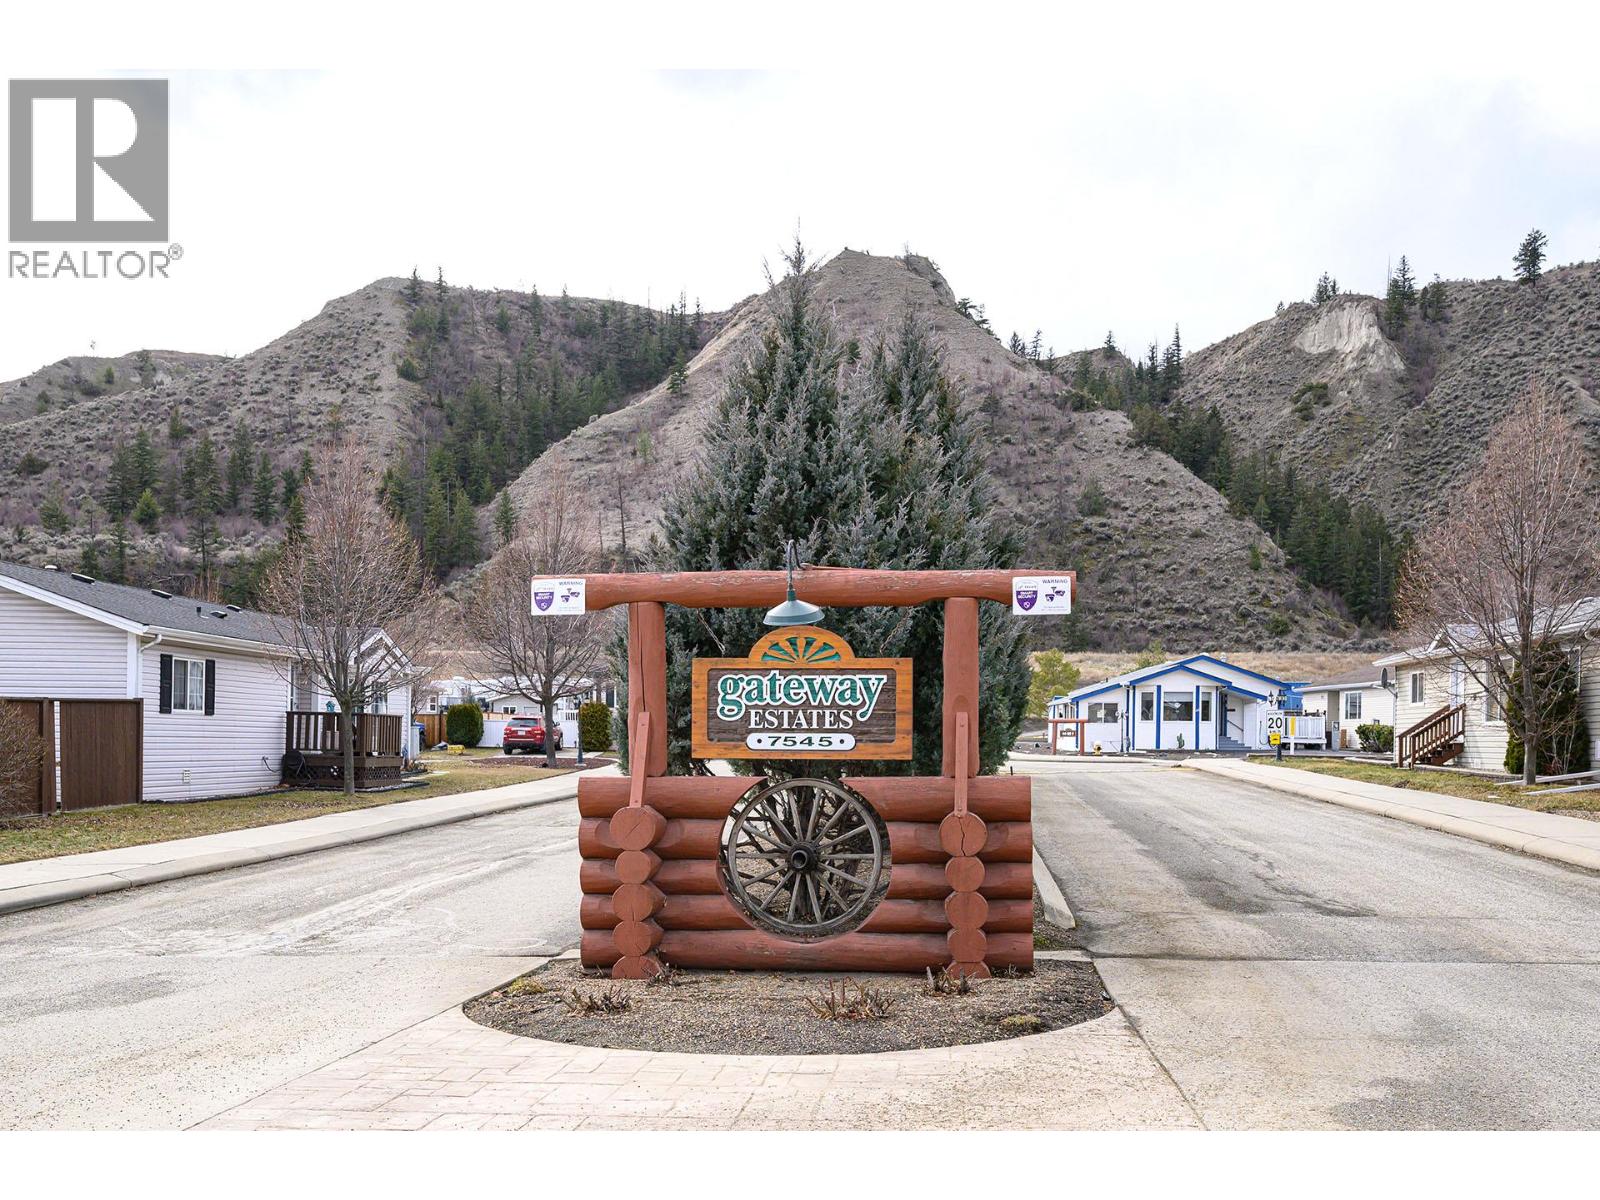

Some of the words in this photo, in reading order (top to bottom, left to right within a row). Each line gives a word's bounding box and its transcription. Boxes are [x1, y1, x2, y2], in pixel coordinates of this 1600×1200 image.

[716, 670, 888, 721] gateway
[748, 709, 853, 729] ESTATES
[1268, 717, 1282, 729] 20
[767, 736, 833, 747] 7545
